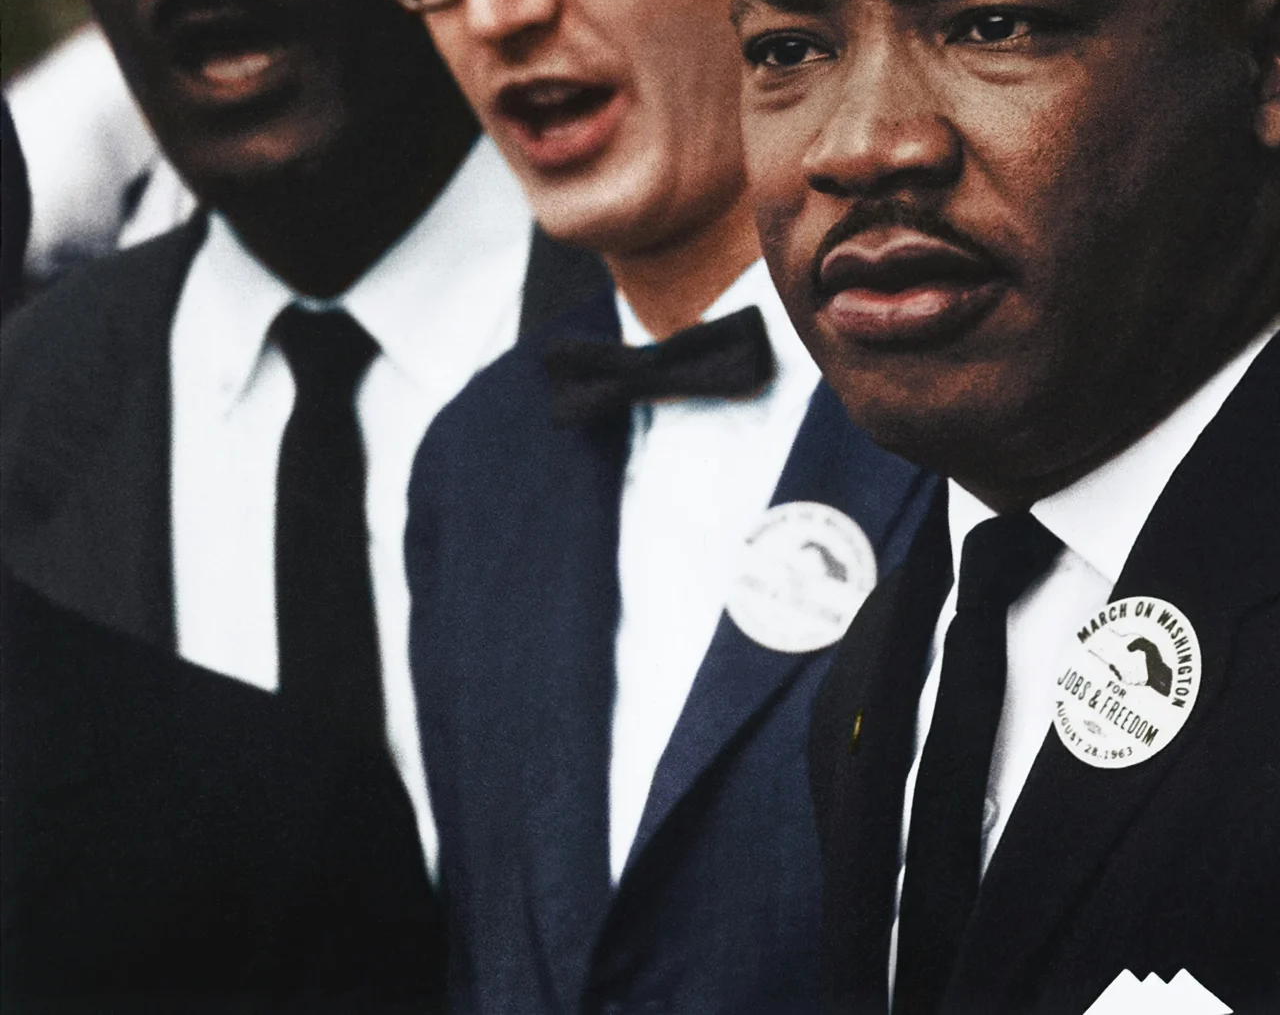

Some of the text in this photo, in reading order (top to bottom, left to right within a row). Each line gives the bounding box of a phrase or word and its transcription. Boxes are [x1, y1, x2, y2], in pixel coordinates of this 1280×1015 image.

[1077, 601, 1193, 709] MARCH ON WASHINGTON
[1057, 668, 1092, 701] JOBS
[1088, 689, 1101, 710] &
[1099, 696, 1160, 748] FREEDOM
[1105, 680, 1127, 699] FOR
[1056, 700, 1083, 747] AUGUST
